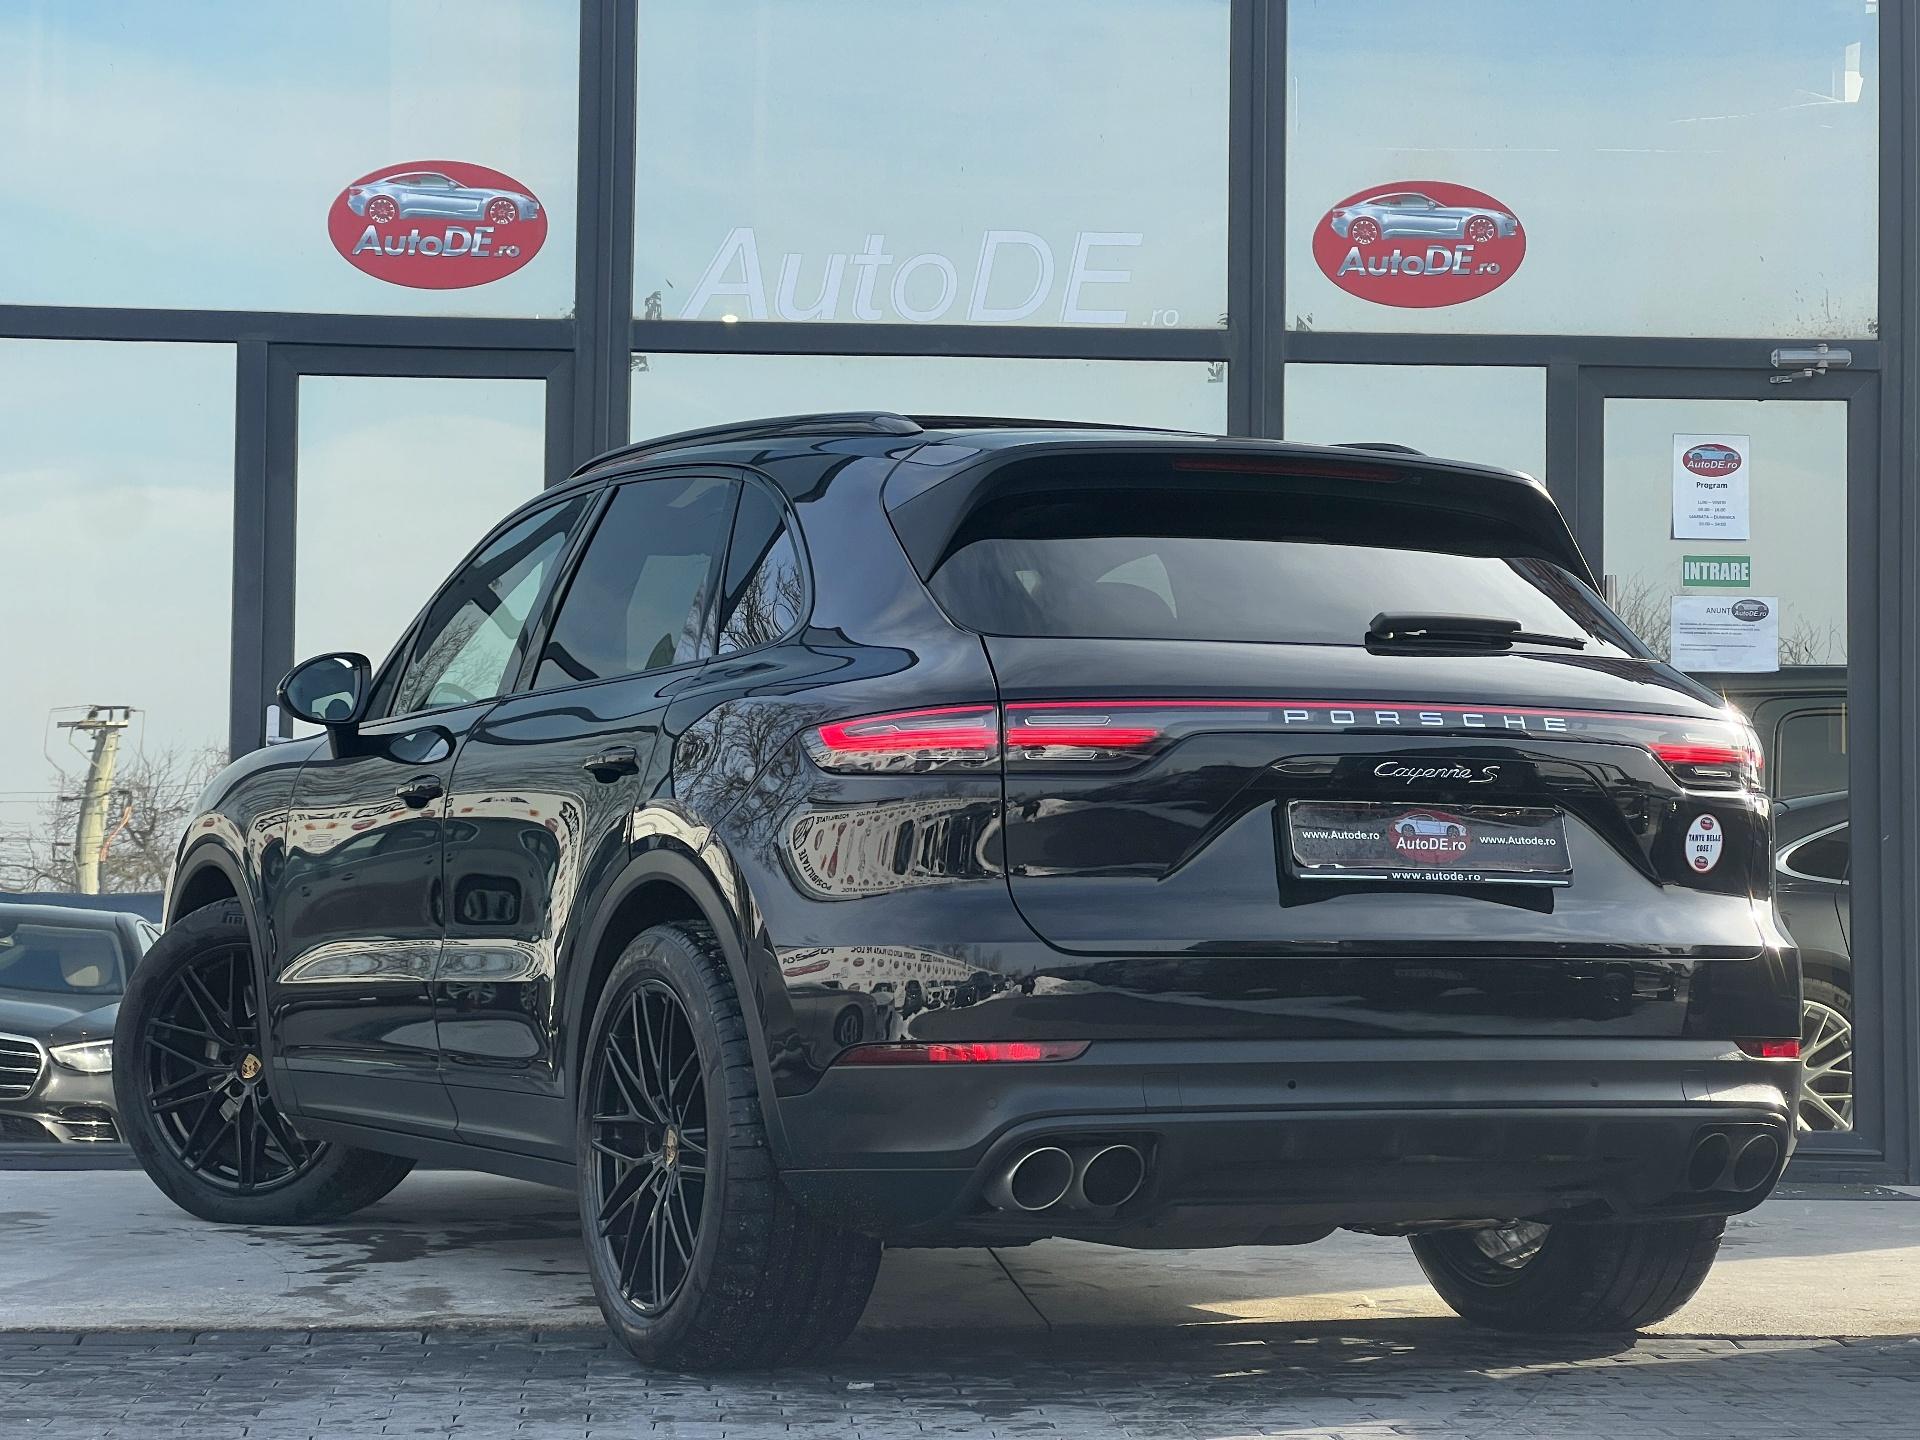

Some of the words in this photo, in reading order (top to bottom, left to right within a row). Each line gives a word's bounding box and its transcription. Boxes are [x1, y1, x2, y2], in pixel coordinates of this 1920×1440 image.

[1687, 460, 1738, 469] AutoDE.ro
[1696, 481, 1728, 490] Program
[1684, 561, 1749, 581] INTRARE
[1283, 708, 1568, 733] PORSCHE
[1373, 761, 1473, 785] Cayenne
[1468, 765, 1501, 784] S
[1302, 829, 1380, 841] www.Autode.ro
[1479, 834, 1557, 847] www.Autode.ro
[1396, 837, 1467, 851] AutoDE.ro
[1391, 870, 1482, 882] www.autode.ro
